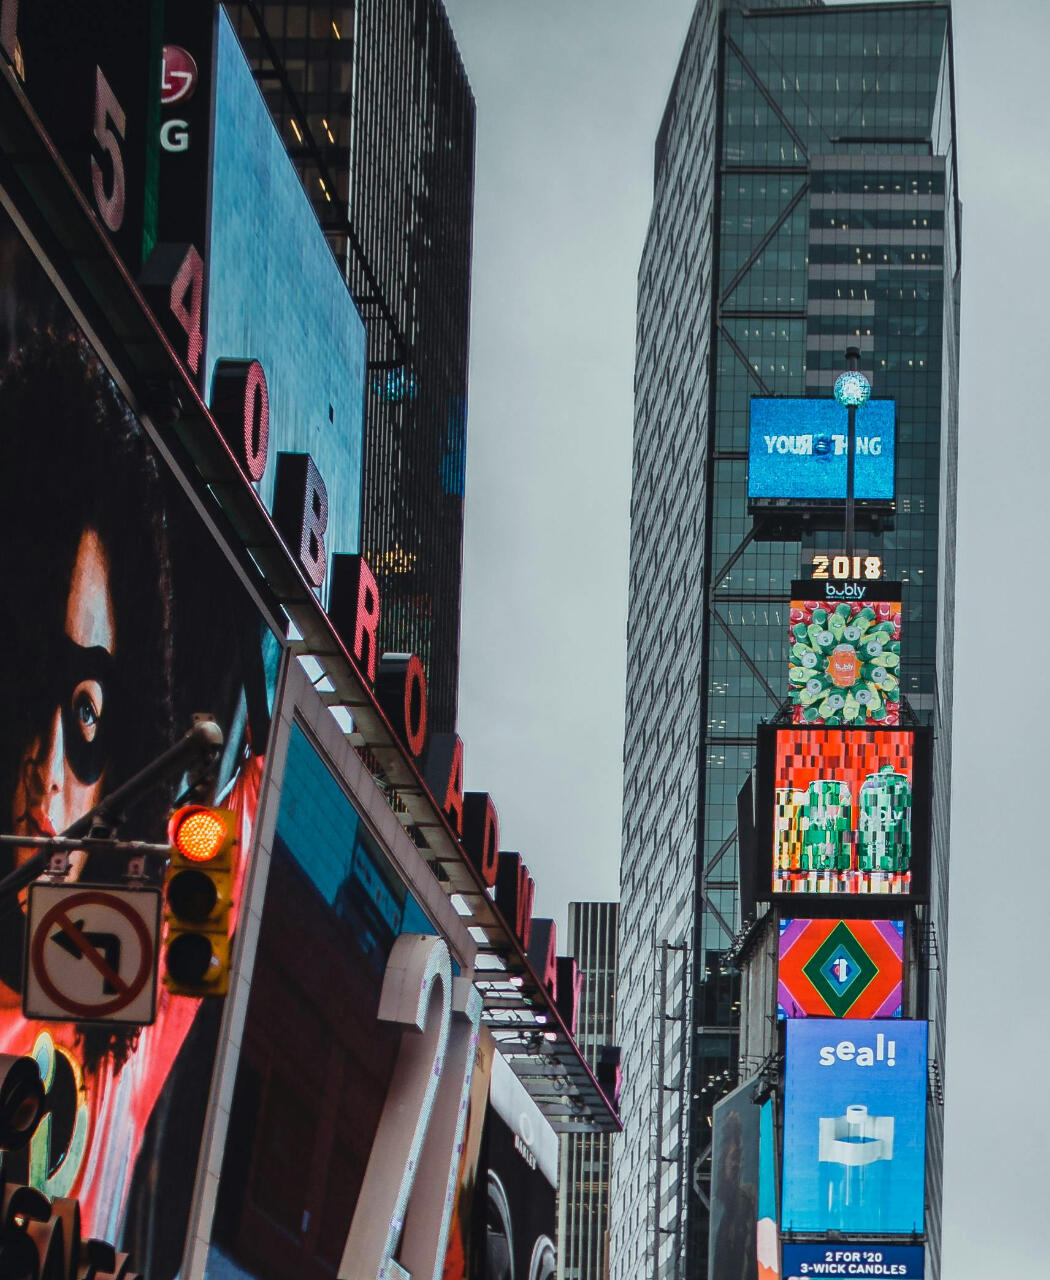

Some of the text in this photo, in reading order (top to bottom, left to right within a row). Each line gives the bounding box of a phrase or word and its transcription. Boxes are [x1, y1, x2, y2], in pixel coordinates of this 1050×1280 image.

[832, 434, 882, 456] THNG
[812, 555, 881, 579] 2018
[298, 453, 583, 1037] BROADWAY
[819, 1033, 896, 1067] seal!
[825, 1252, 882, 1262] 2 FOR $20
[800, 1263, 907, 1275] 3-WICK CANDLES
